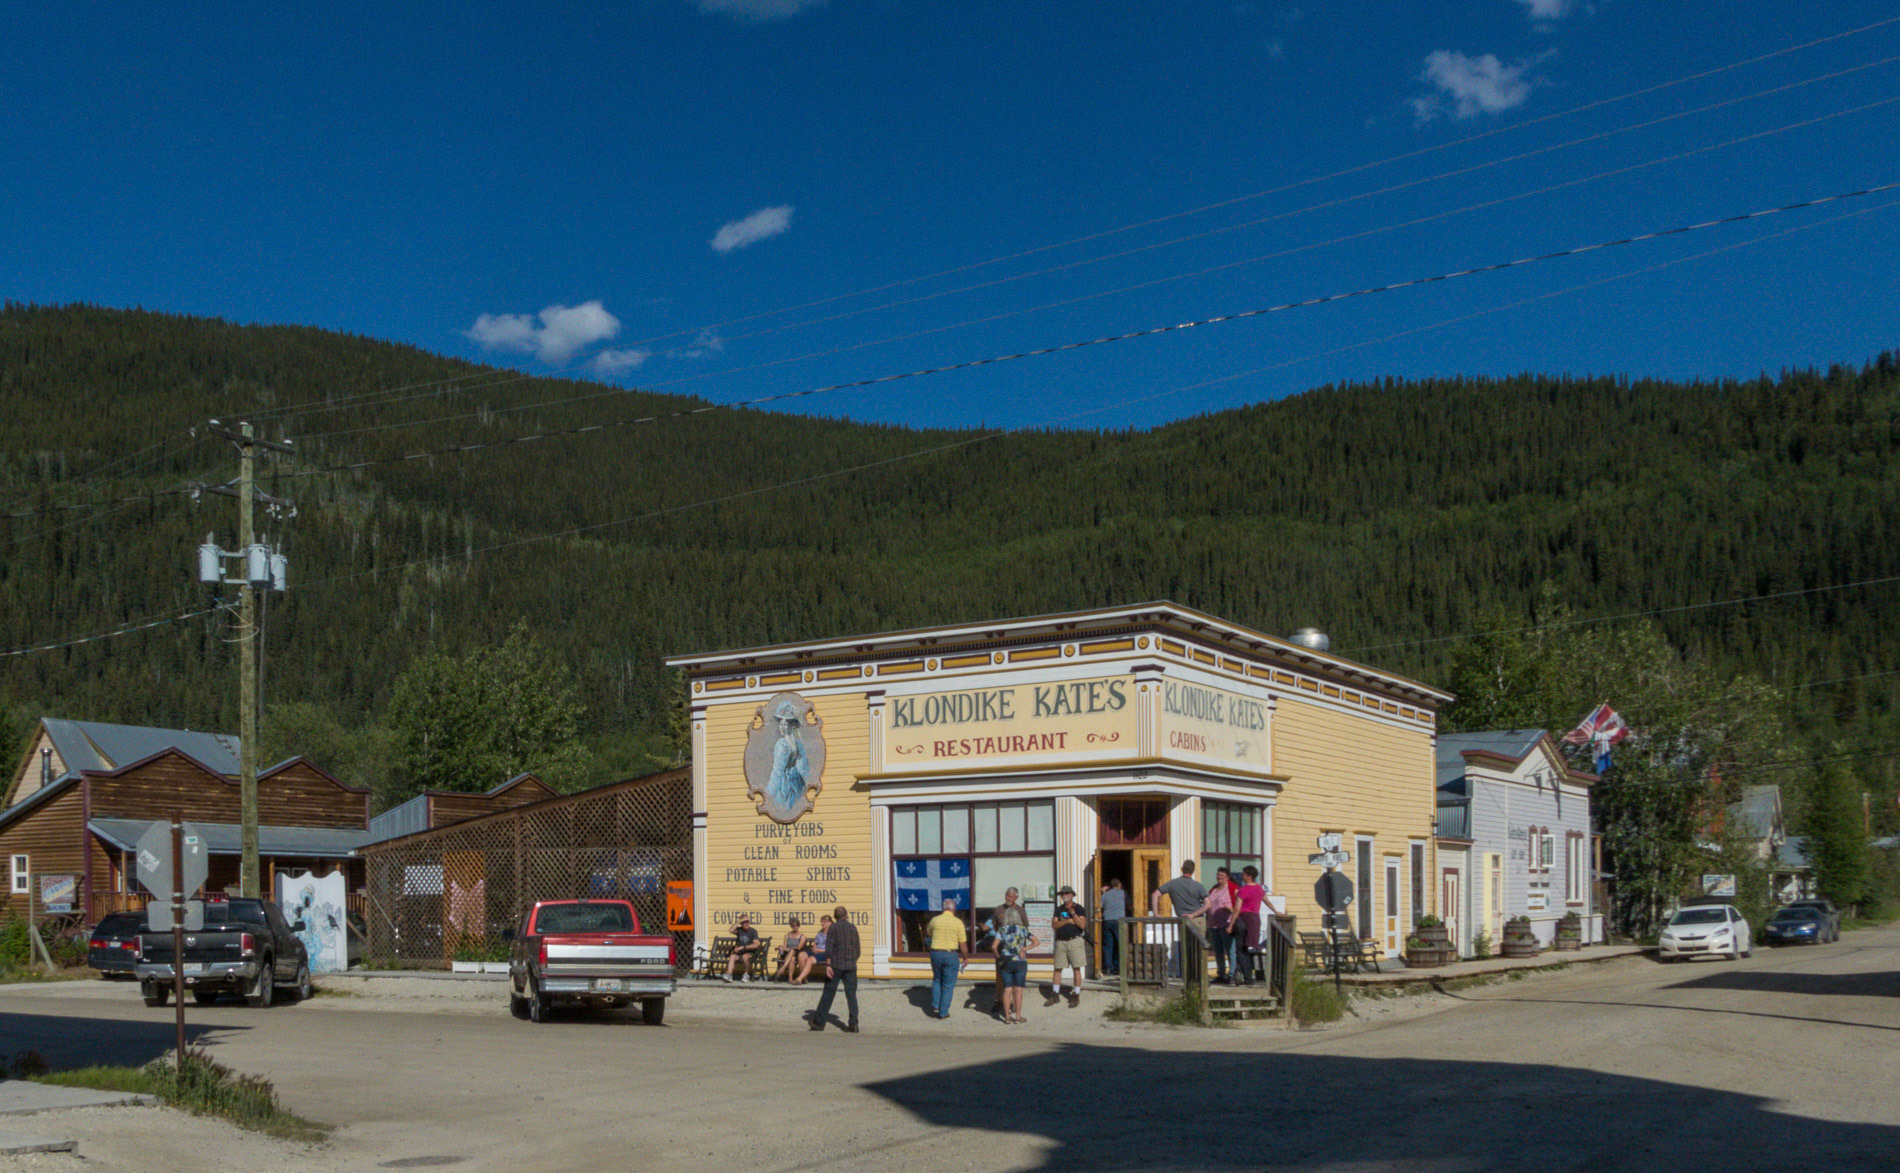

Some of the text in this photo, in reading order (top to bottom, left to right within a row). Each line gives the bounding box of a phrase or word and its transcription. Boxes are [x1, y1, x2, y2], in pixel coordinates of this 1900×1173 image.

[892, 679, 1127, 728] KLONDIKE KATE'S
[1164, 681, 1224, 723] KLONDIKE
[933, 732, 1068, 757] RESTAURANT
[1170, 730, 1206, 752] CABINS
[755, 822, 824, 838] PURVEYORS
[744, 844, 837, 860] CLEAN ROOMS
[726, 866, 851, 882] POTABLE SPIRITS
[743, 889, 837, 904] & FINE FOODS
[713, 911, 763, 925] COVEED
